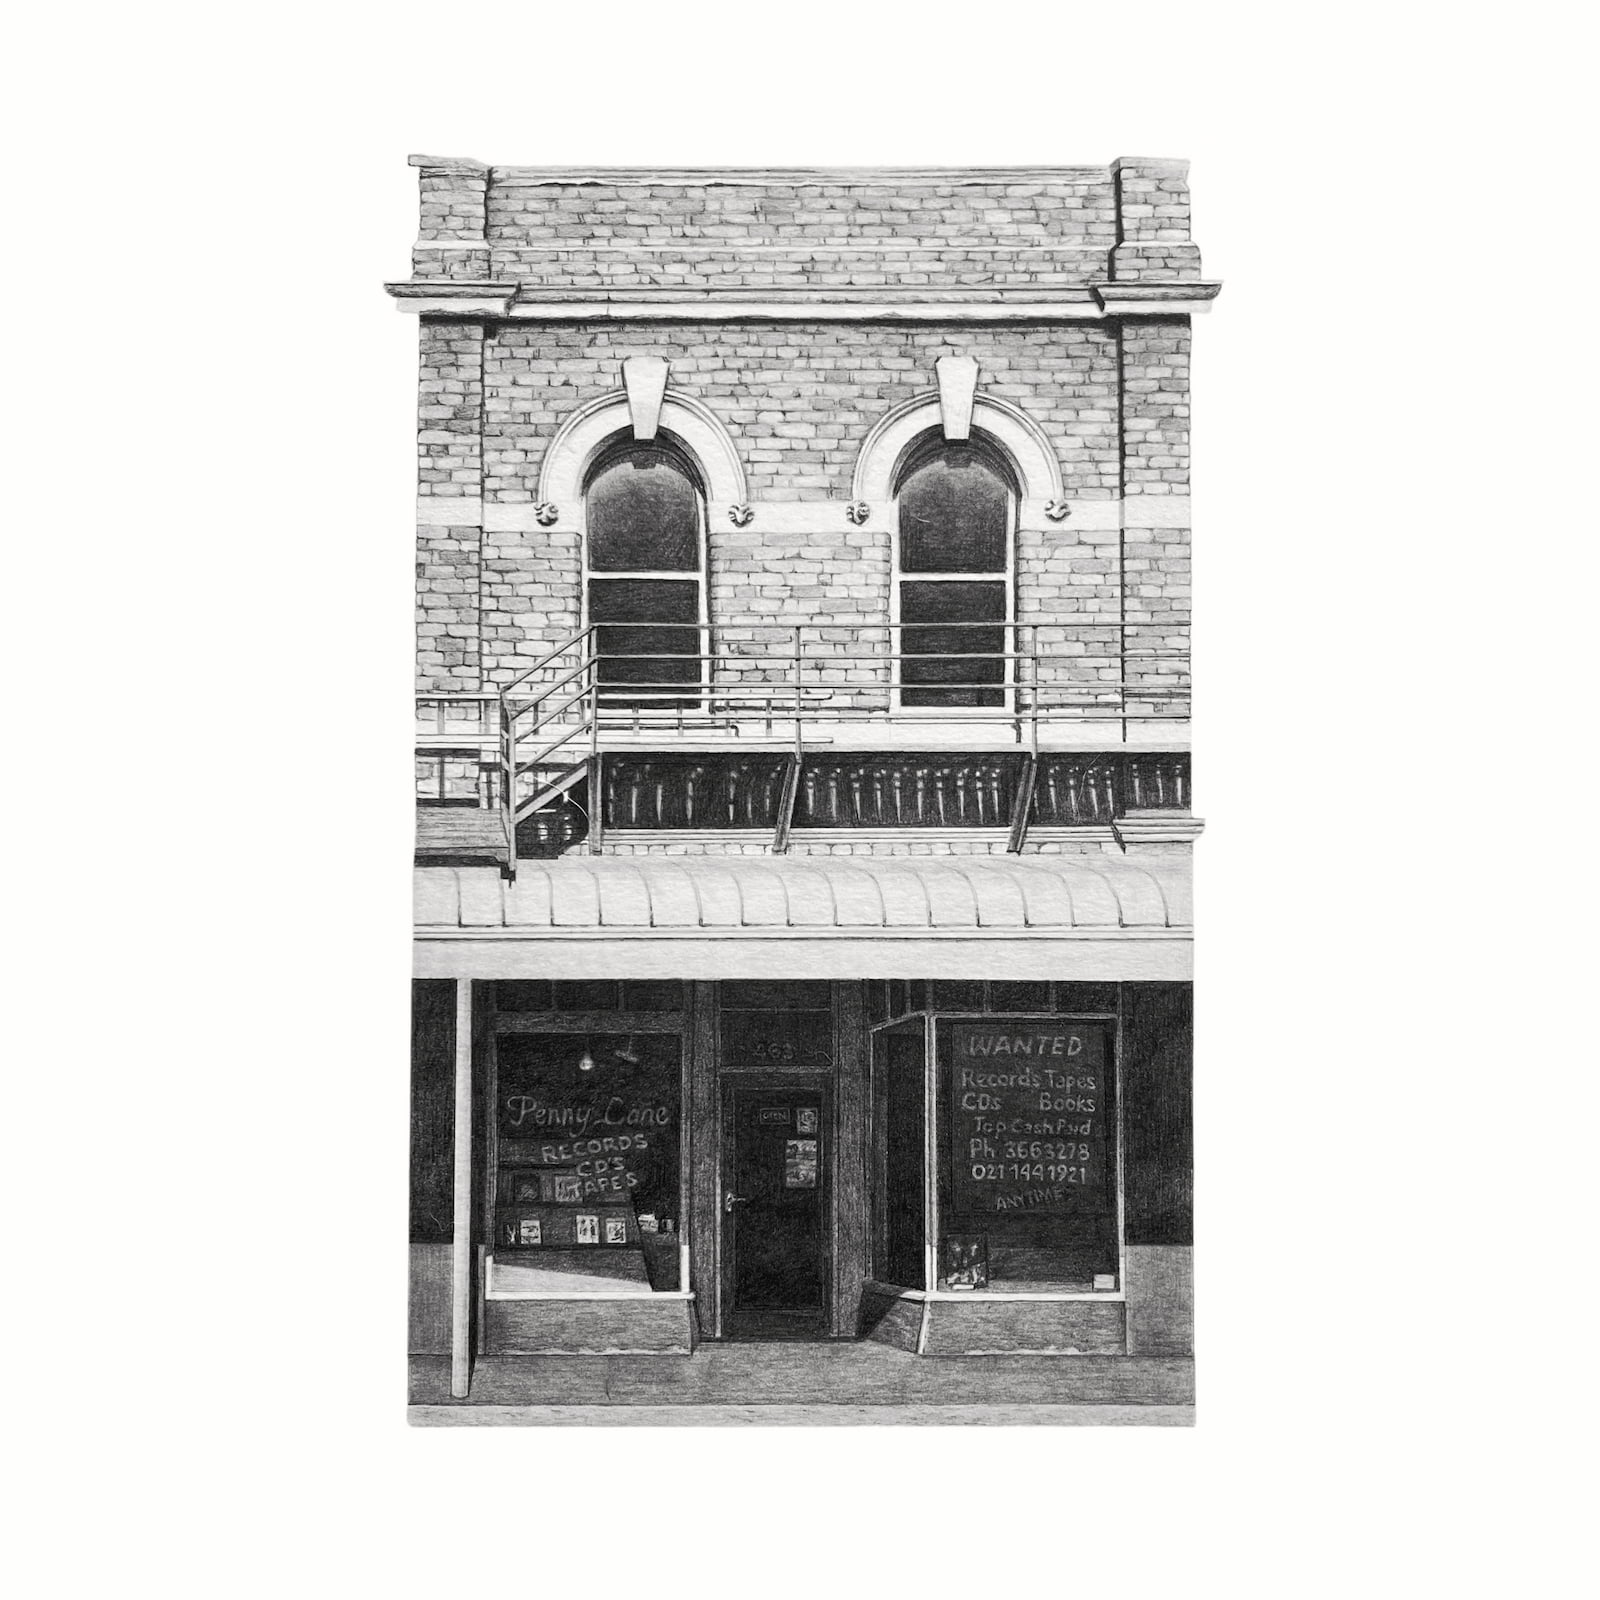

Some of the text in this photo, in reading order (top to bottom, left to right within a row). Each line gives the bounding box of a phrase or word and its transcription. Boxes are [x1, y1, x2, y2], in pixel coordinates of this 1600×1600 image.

[969, 1036, 1082, 1056] WANTED
[962, 1067, 1096, 1093] Records Tapes
[962, 1092, 1096, 1112] CDs Books
[507, 1096, 593, 1137] Penny
[1011, 1119, 1053, 1135] Cash
[541, 1133, 648, 1163] RECORDS
[970, 1138, 1090, 1161] Ph 3663278
[576, 1157, 625, 1176] CD'S
[567, 1172, 638, 1199] TAPES
